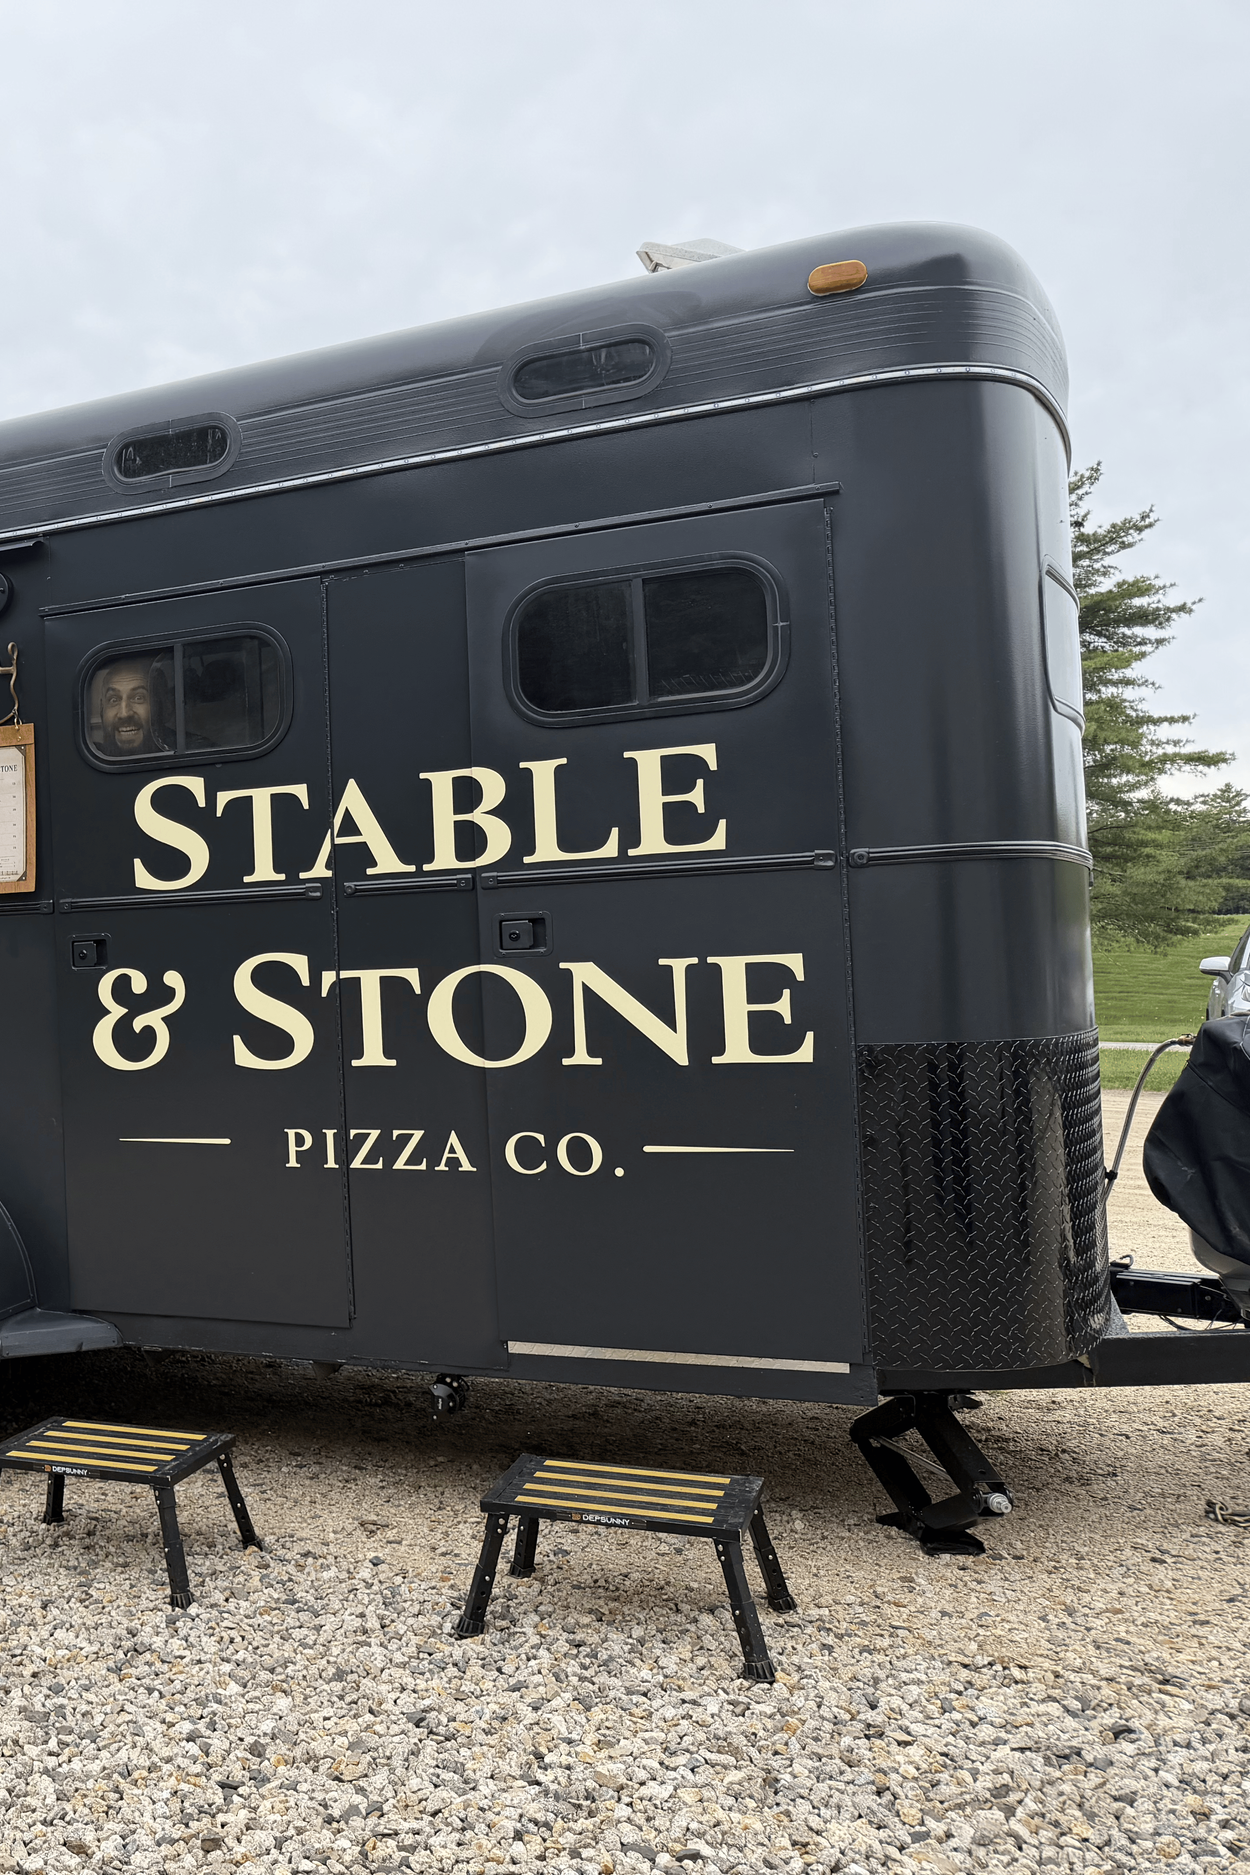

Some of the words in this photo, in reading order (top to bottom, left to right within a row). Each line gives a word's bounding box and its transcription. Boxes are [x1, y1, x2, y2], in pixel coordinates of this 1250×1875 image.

[133, 742, 727, 891] STABLE
[92, 967, 186, 1071] &
[232, 952, 814, 1070] STONE
[283, 1128, 477, 1172] PIZZA
[504, 1131, 625, 1177] CO.
